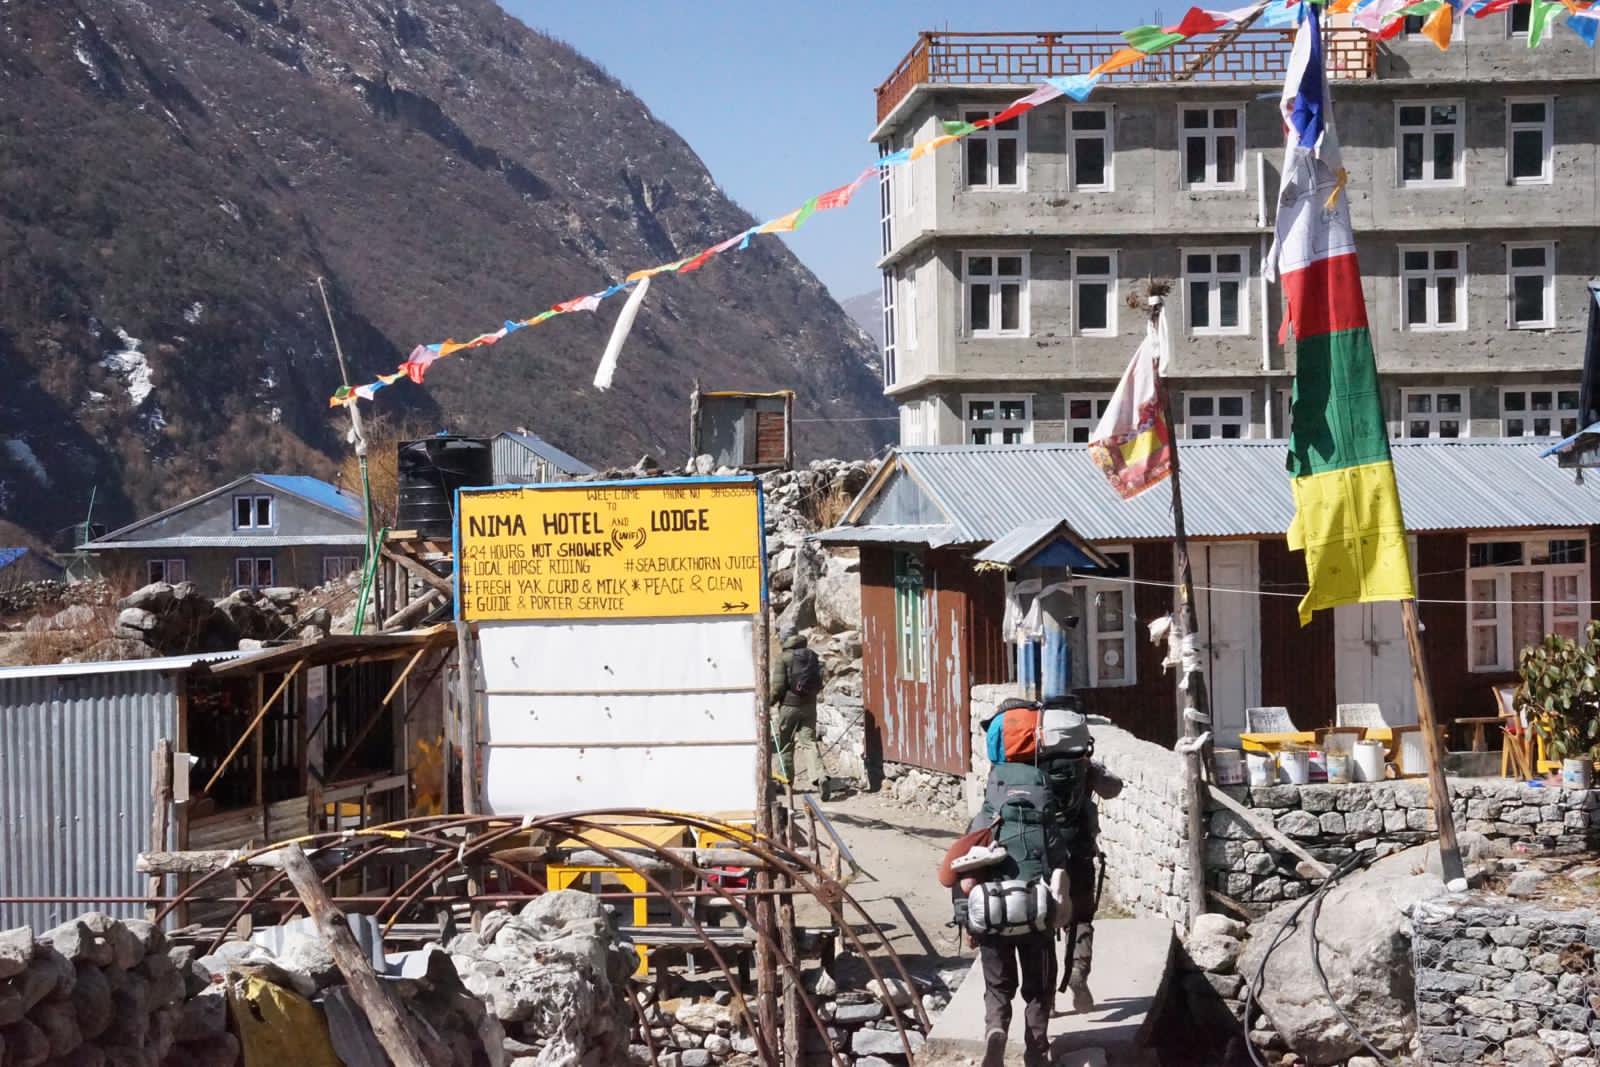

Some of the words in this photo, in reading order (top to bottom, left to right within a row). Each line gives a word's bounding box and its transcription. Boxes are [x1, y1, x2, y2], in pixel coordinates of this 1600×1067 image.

[606, 502, 617, 511] TO
[469, 514, 527, 537] NIMA
[543, 512, 604, 535] HOTEL
[611, 517, 630, 527] AND
[651, 509, 710, 532] LODGE
[490, 544, 525, 559] HOURS
[531, 543, 553, 558] HOT
[557, 542, 614, 558] SHOWER
[474, 561, 502, 576] LOCAL
[508, 560, 543, 575] HORSE
[549, 559, 591, 575] RIDING
[725, 555, 759, 570] JUICE
[475, 580, 511, 595] FRESH
[518, 580, 543, 594] YAK
[547, 579, 579, 594] CURD
[582, 579, 592, 594] &
[597, 578, 631, 596] MILK
[643, 577, 685, 595] PEACE
[689, 574, 704, 593] &
[707, 575, 743, 592] CLEAN
[476, 596, 511, 612] GUIDE
[531, 595, 573, 610] PORTER
[578, 596, 625, 611] SERVICE
